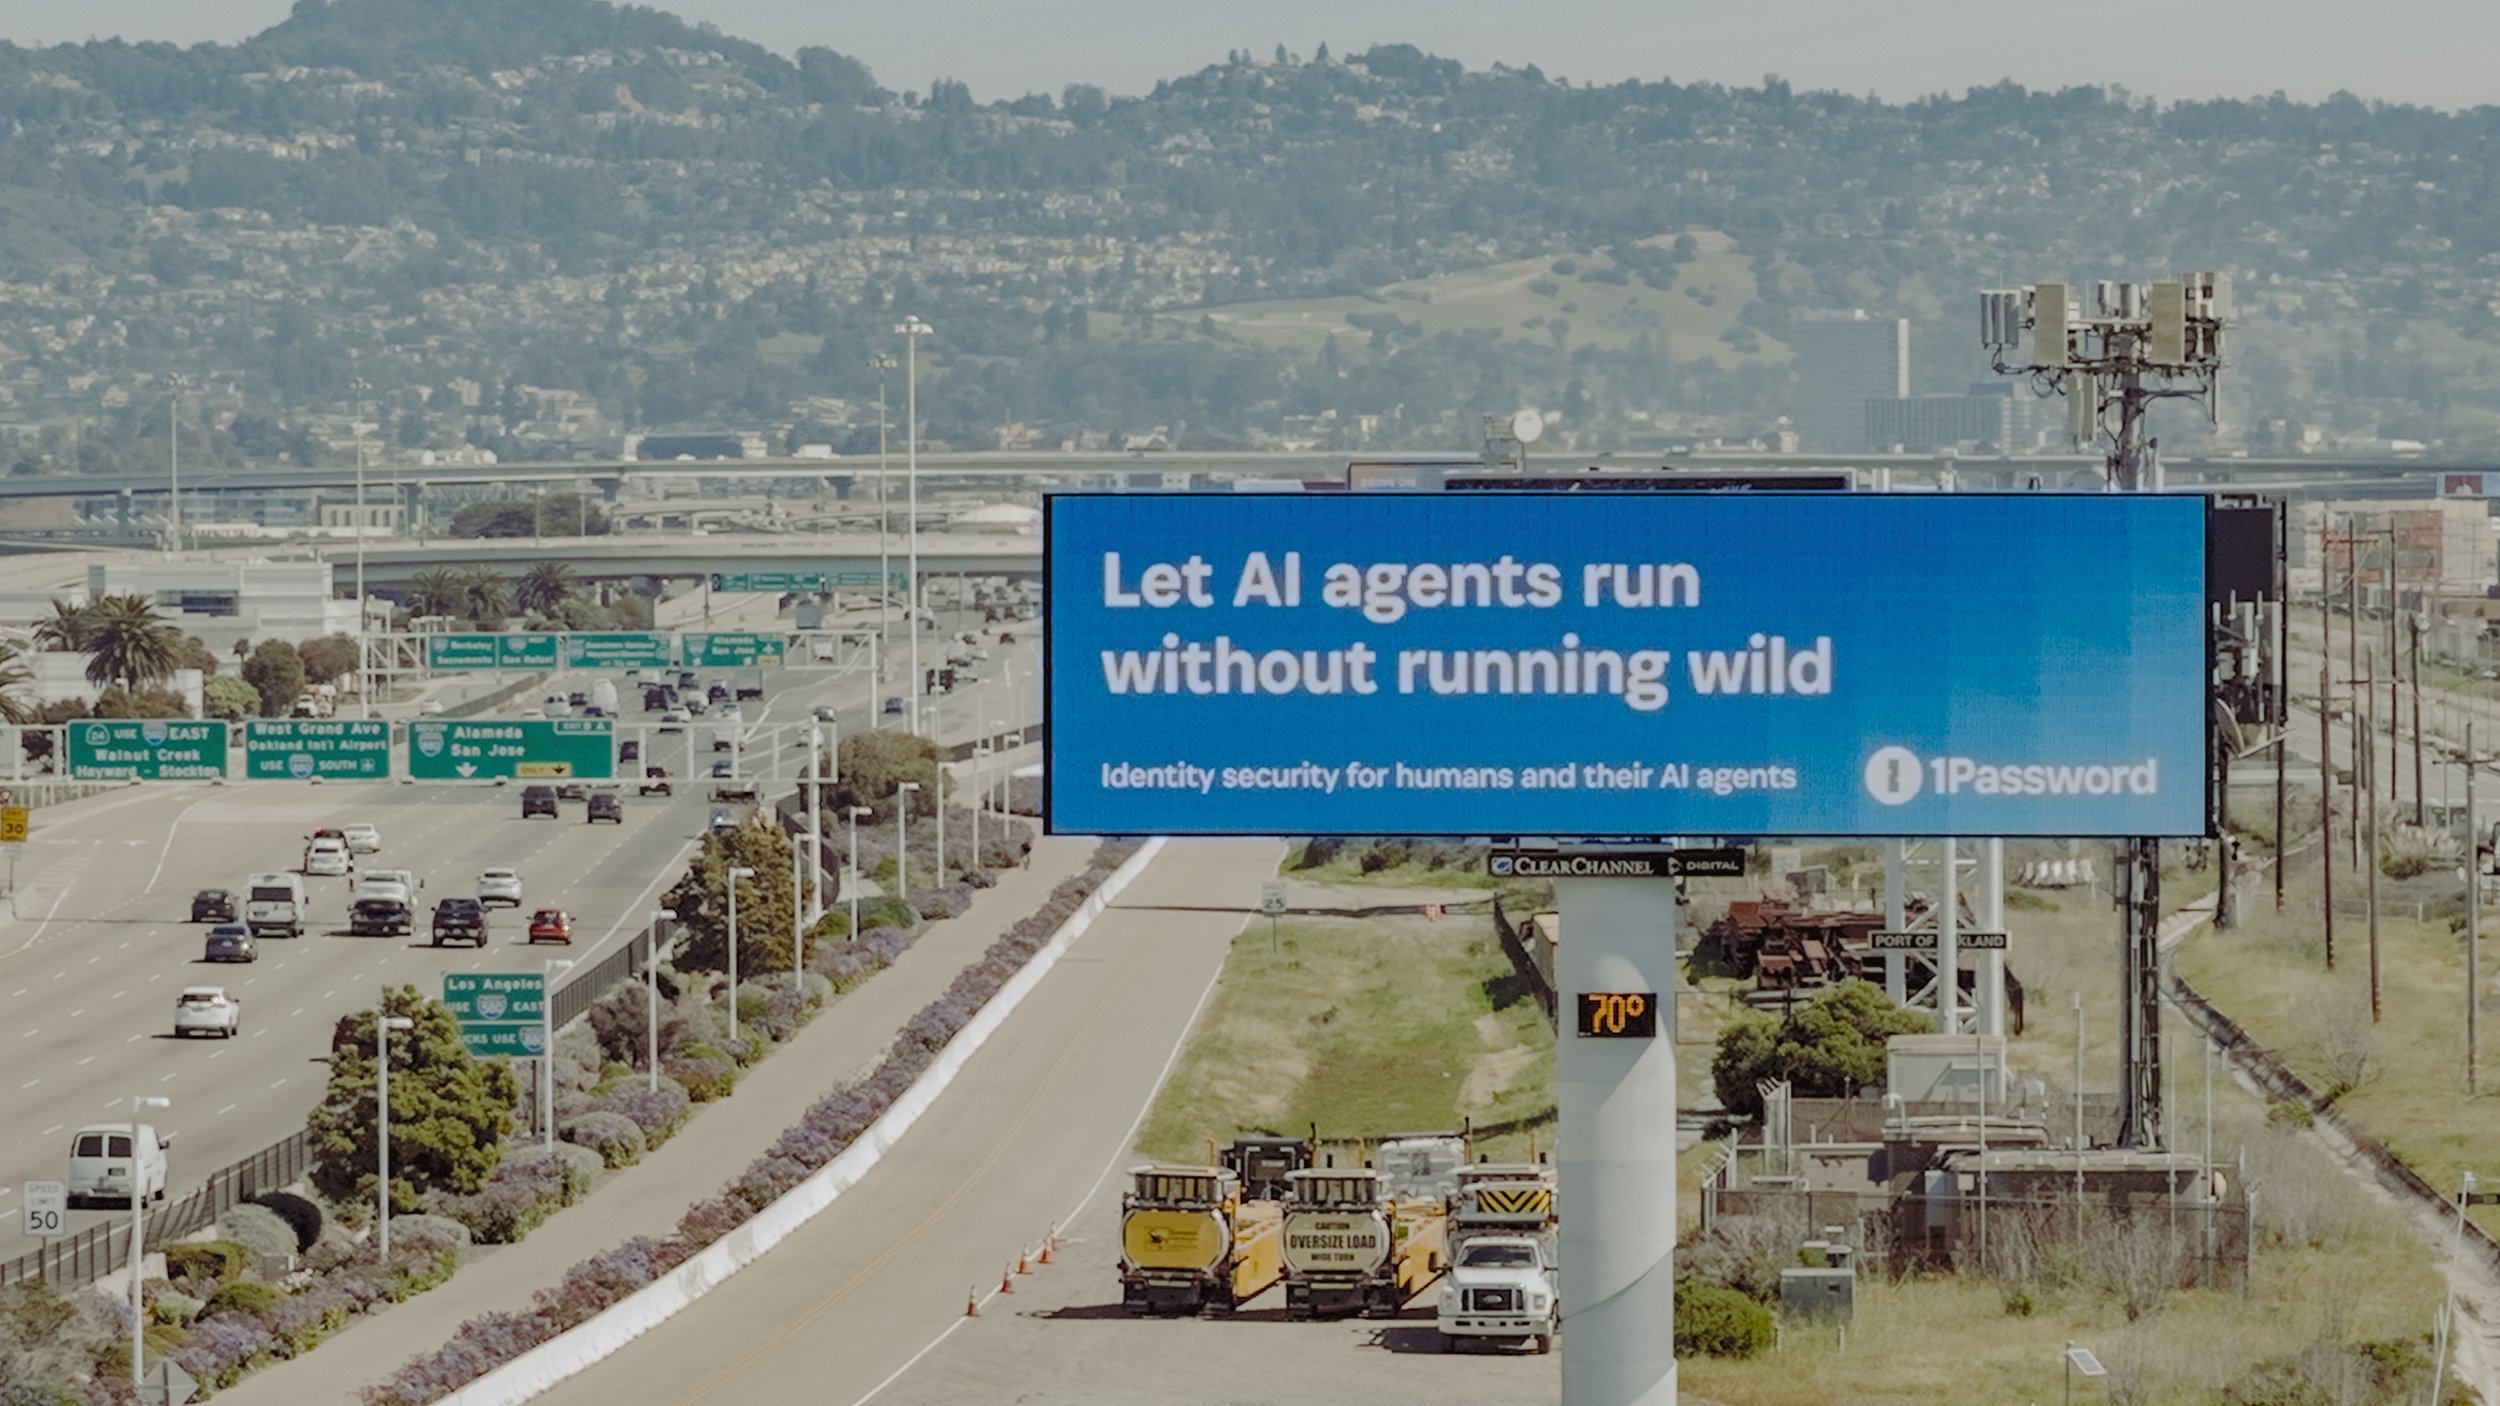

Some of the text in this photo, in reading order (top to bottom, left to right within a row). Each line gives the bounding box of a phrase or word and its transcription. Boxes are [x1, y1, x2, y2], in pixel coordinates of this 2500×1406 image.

[1104, 552, 1700, 624] Let AI agents run
[1101, 632, 1832, 711] without running wild
[114, 728, 137, 739] USE
[169, 727, 209, 740] EAST
[254, 722, 381, 736] West Grand Ave
[453, 725, 524, 740] Alameda
[248, 739, 303, 751] Oakland
[339, 739, 388, 752] Airport
[450, 743, 525, 757] San Jose
[95, 748, 201, 762] Walnut Creek
[76, 764, 137, 779] Hayward
[159, 764, 220, 778] Stockton
[260, 760, 284, 771] USE
[318, 759, 358, 771] SOUTH
[1102, 760, 1798, 796] Identity security for humans and their AI agents
[1931, 758, 2157, 796] 1Password
[5, 823, 24, 834] 30
[1686, 860, 1739, 871] DIGITAL
[1264, 898, 1285, 909] 25
[1875, 935, 2004, 947] PORT OF KLAND
[447, 978, 543, 993] Los Angeles
[512, 1001, 544, 1012] EAST
[492, 1033, 516, 1044] USE
[28, 1183, 59, 1193] SPEED
[31, 1197, 55, 1206] LIMIT
[30, 1211, 59, 1230] 50
[1315, 1221, 1350, 1230] CAUTION
[1290, 1235, 1376, 1249] OVERSIZE LOAD
[1311, 1253, 1354, 1261] WIDE TURN
